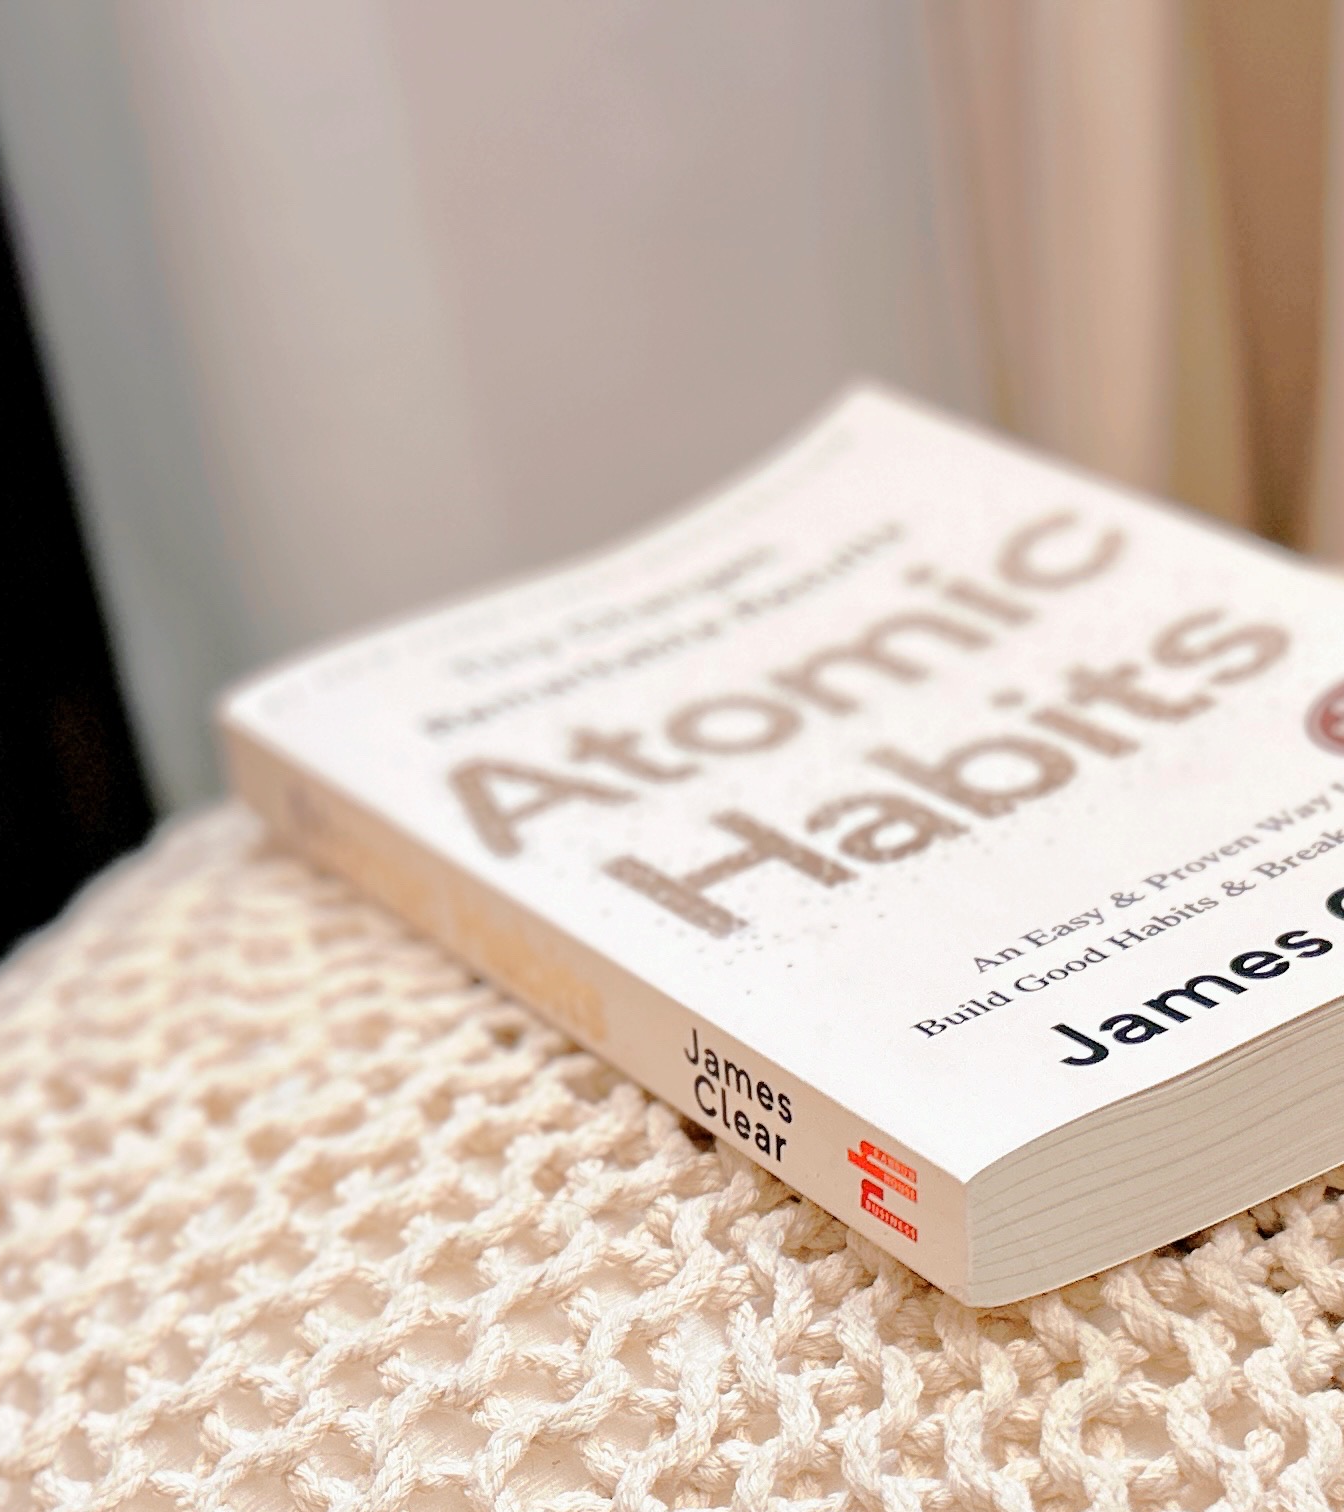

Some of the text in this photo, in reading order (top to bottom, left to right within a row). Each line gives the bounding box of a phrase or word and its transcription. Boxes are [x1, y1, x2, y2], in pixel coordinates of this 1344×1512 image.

[445, 510, 1127, 861] Atomic
[598, 606, 1293, 940] Habits
[909, 989, 1015, 1040] Build
[1013, 946, 1112, 993] Good
[1102, 895, 1220, 951] Habits
[1220, 879, 1257, 898] &
[972, 946, 1026, 974] An
[1018, 907, 1105, 949] Easy
[1109, 891, 1147, 909] &
[1141, 834, 1261, 892] Proven
[1255, 793, 1333, 833] Way
[683, 1027, 794, 1124] James
[1049, 929, 1334, 1067] James
[694, 1074, 788, 1162] Clear
